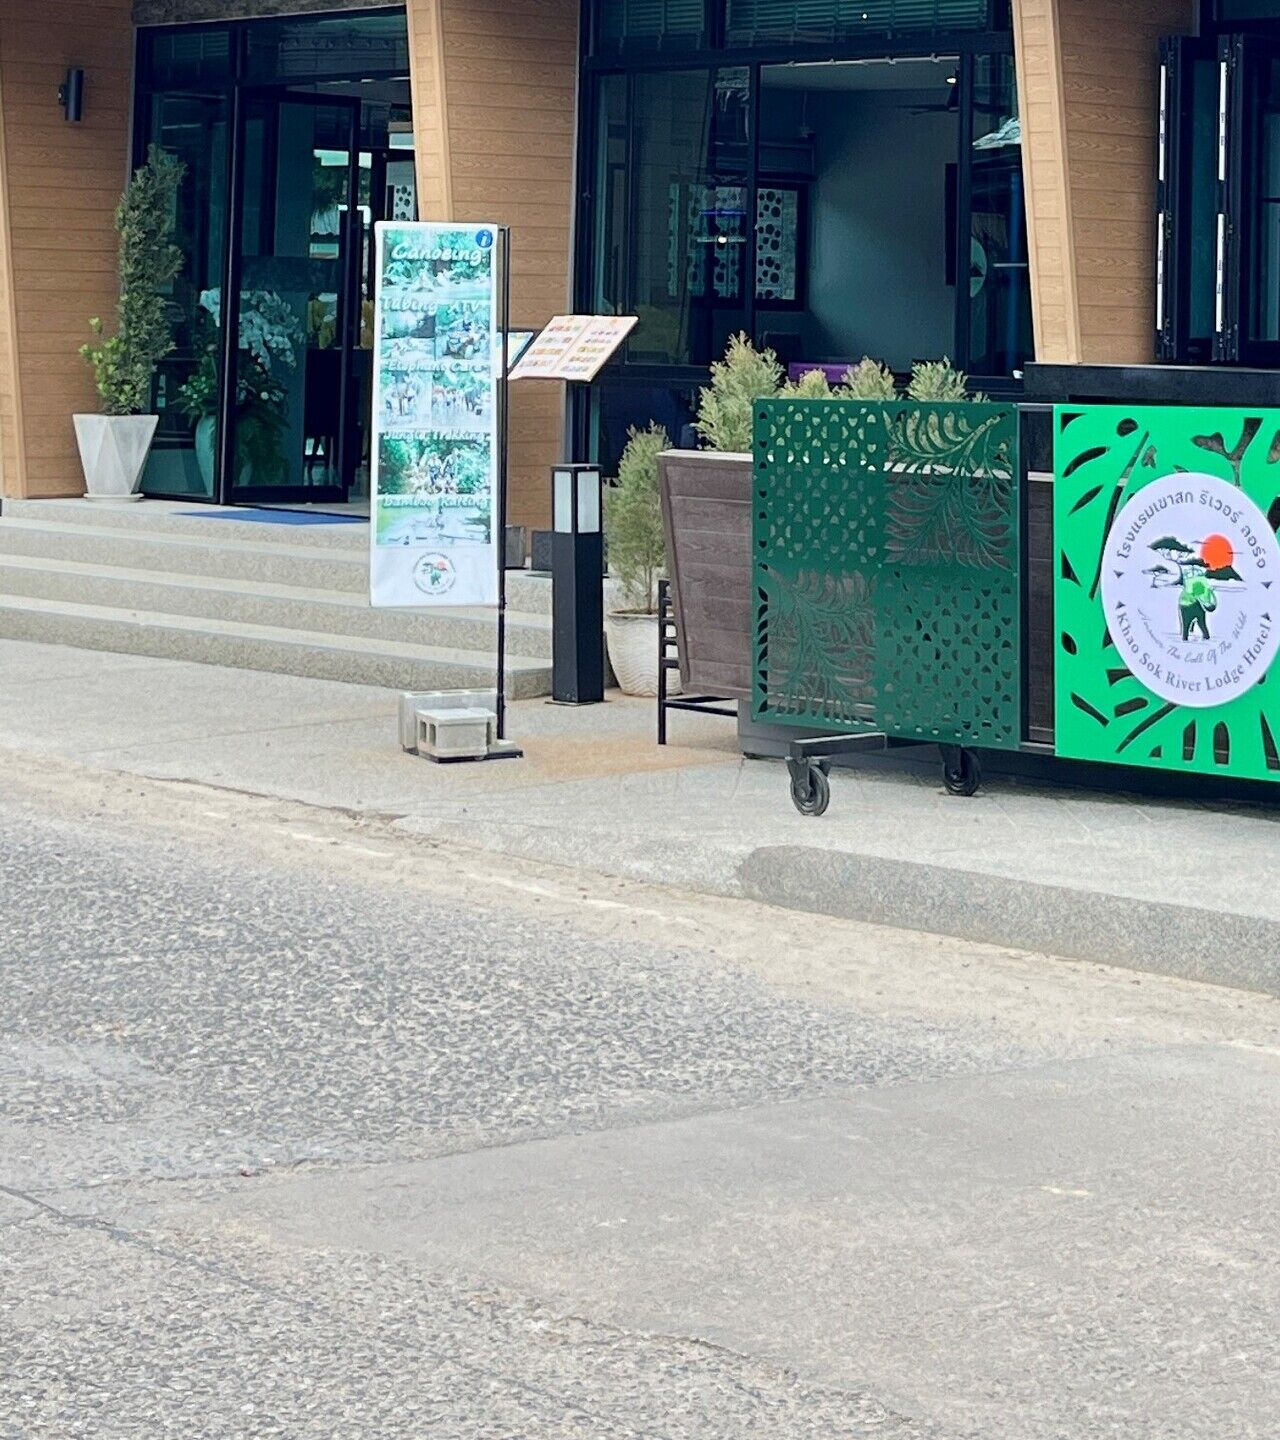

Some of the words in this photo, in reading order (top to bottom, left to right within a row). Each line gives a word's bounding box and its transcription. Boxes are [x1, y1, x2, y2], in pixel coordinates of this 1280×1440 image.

[391, 242, 482, 267] Canoeing
[1117, 611, 1139, 653] Khao
[1139, 652, 1162, 679] Sok
[1165, 669, 1202, 692] River
[1205, 662, 1244, 691] Lodge
[1243, 622, 1272, 666] Hotel
